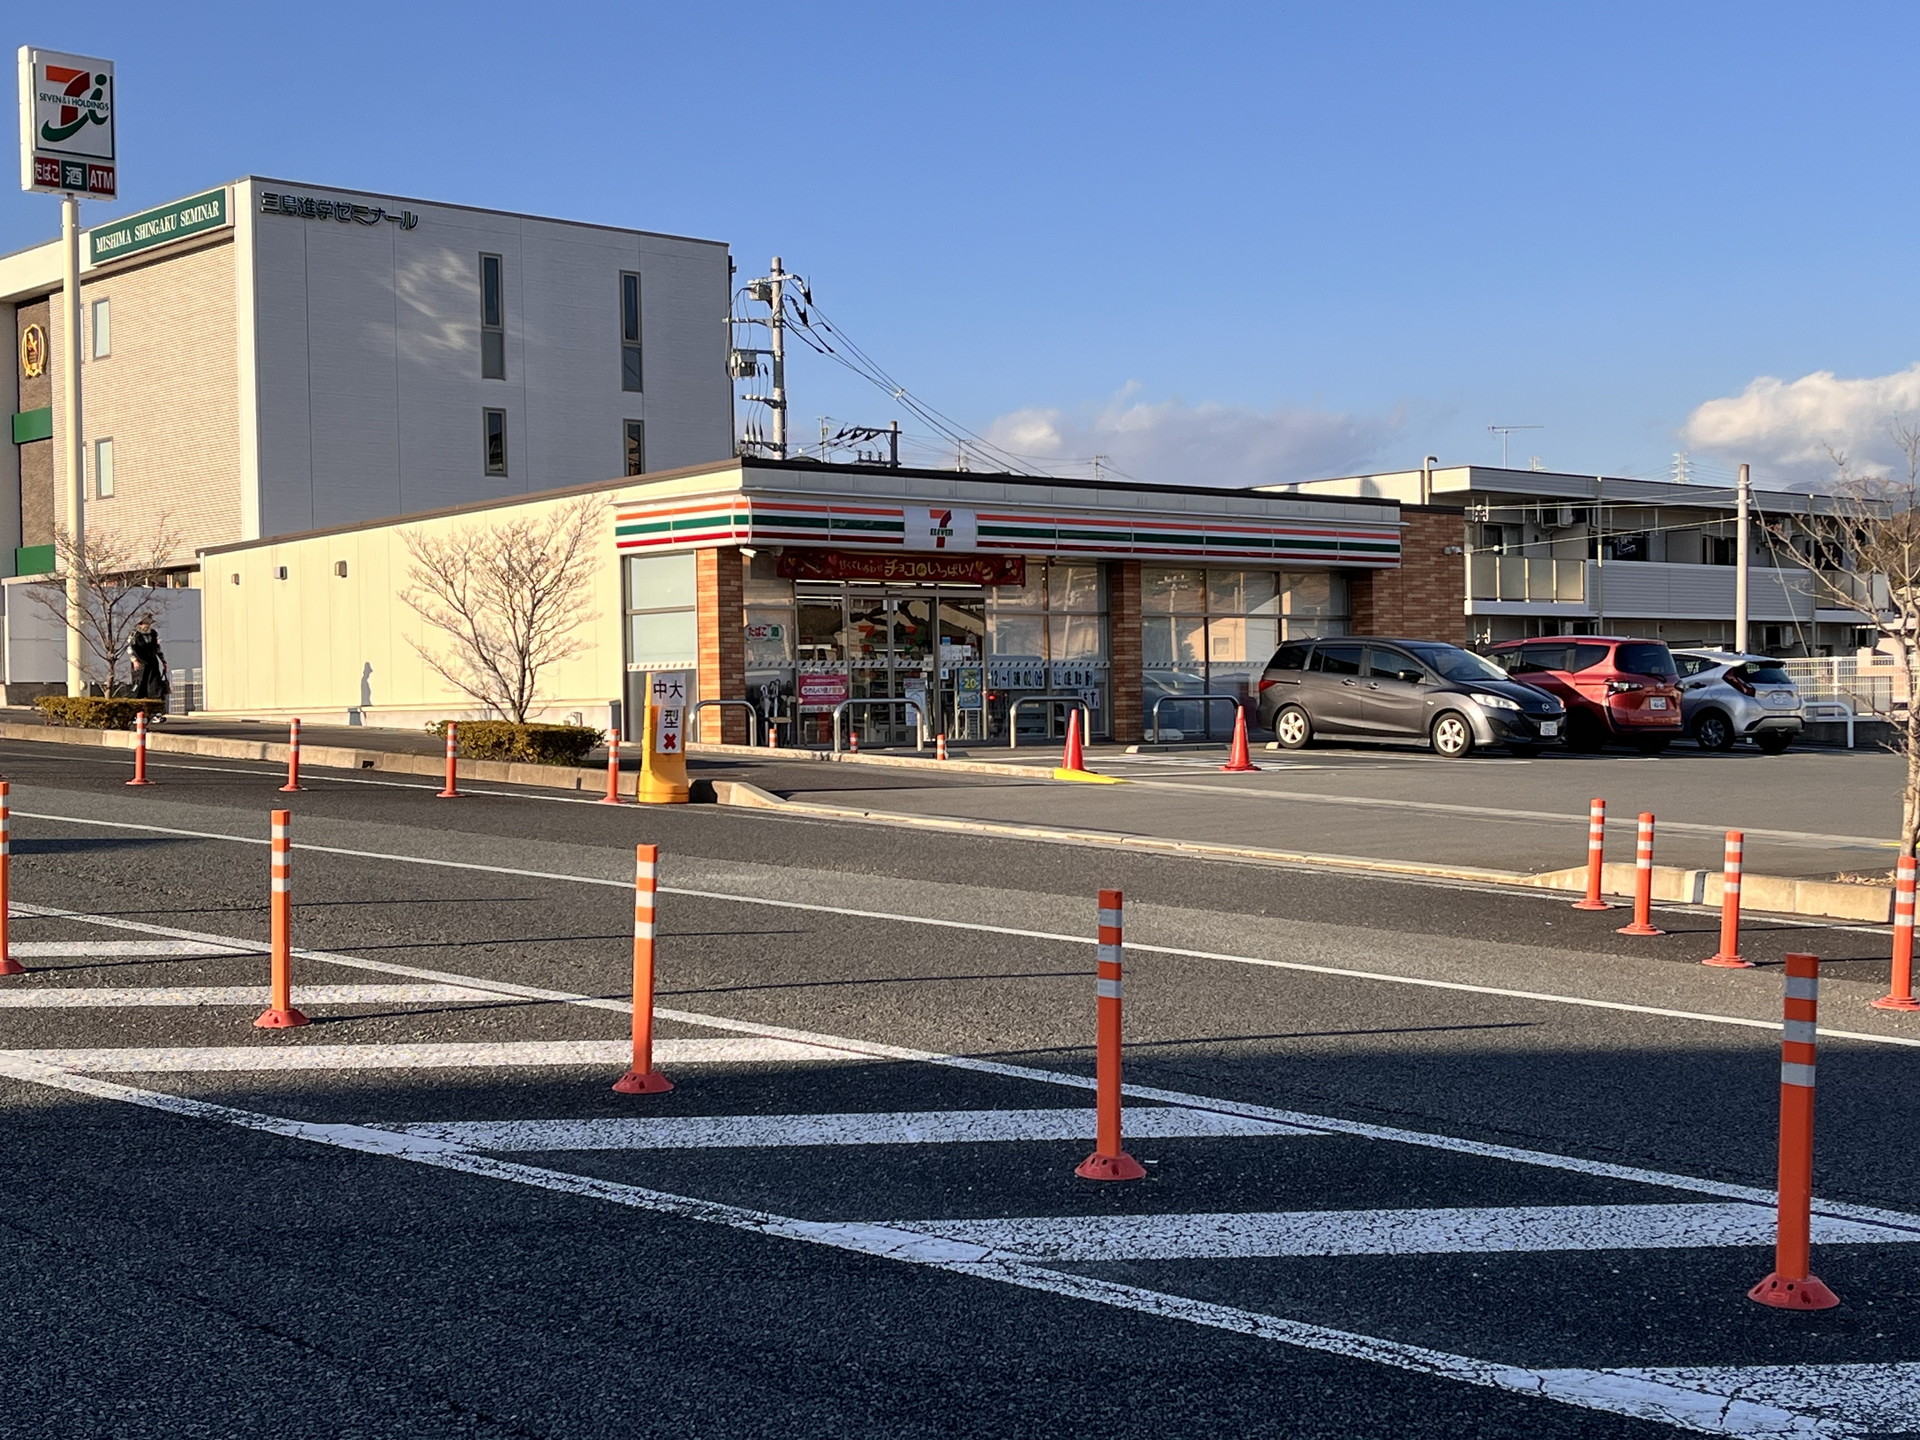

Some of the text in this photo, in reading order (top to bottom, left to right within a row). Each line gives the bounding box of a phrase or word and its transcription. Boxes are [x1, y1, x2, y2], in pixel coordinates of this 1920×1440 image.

[72, 97, 110, 112] HOLDINGS
[34, 162, 59, 182] たばこ
[66, 166, 82, 185] 酒
[90, 170, 113, 190] ATM
[260, 191, 419, 230] 三島進学ゼミナール
[96, 200, 219, 253] MISHIMA SHINGAKU SEMINAR
[664, 709, 678, 729] 型
